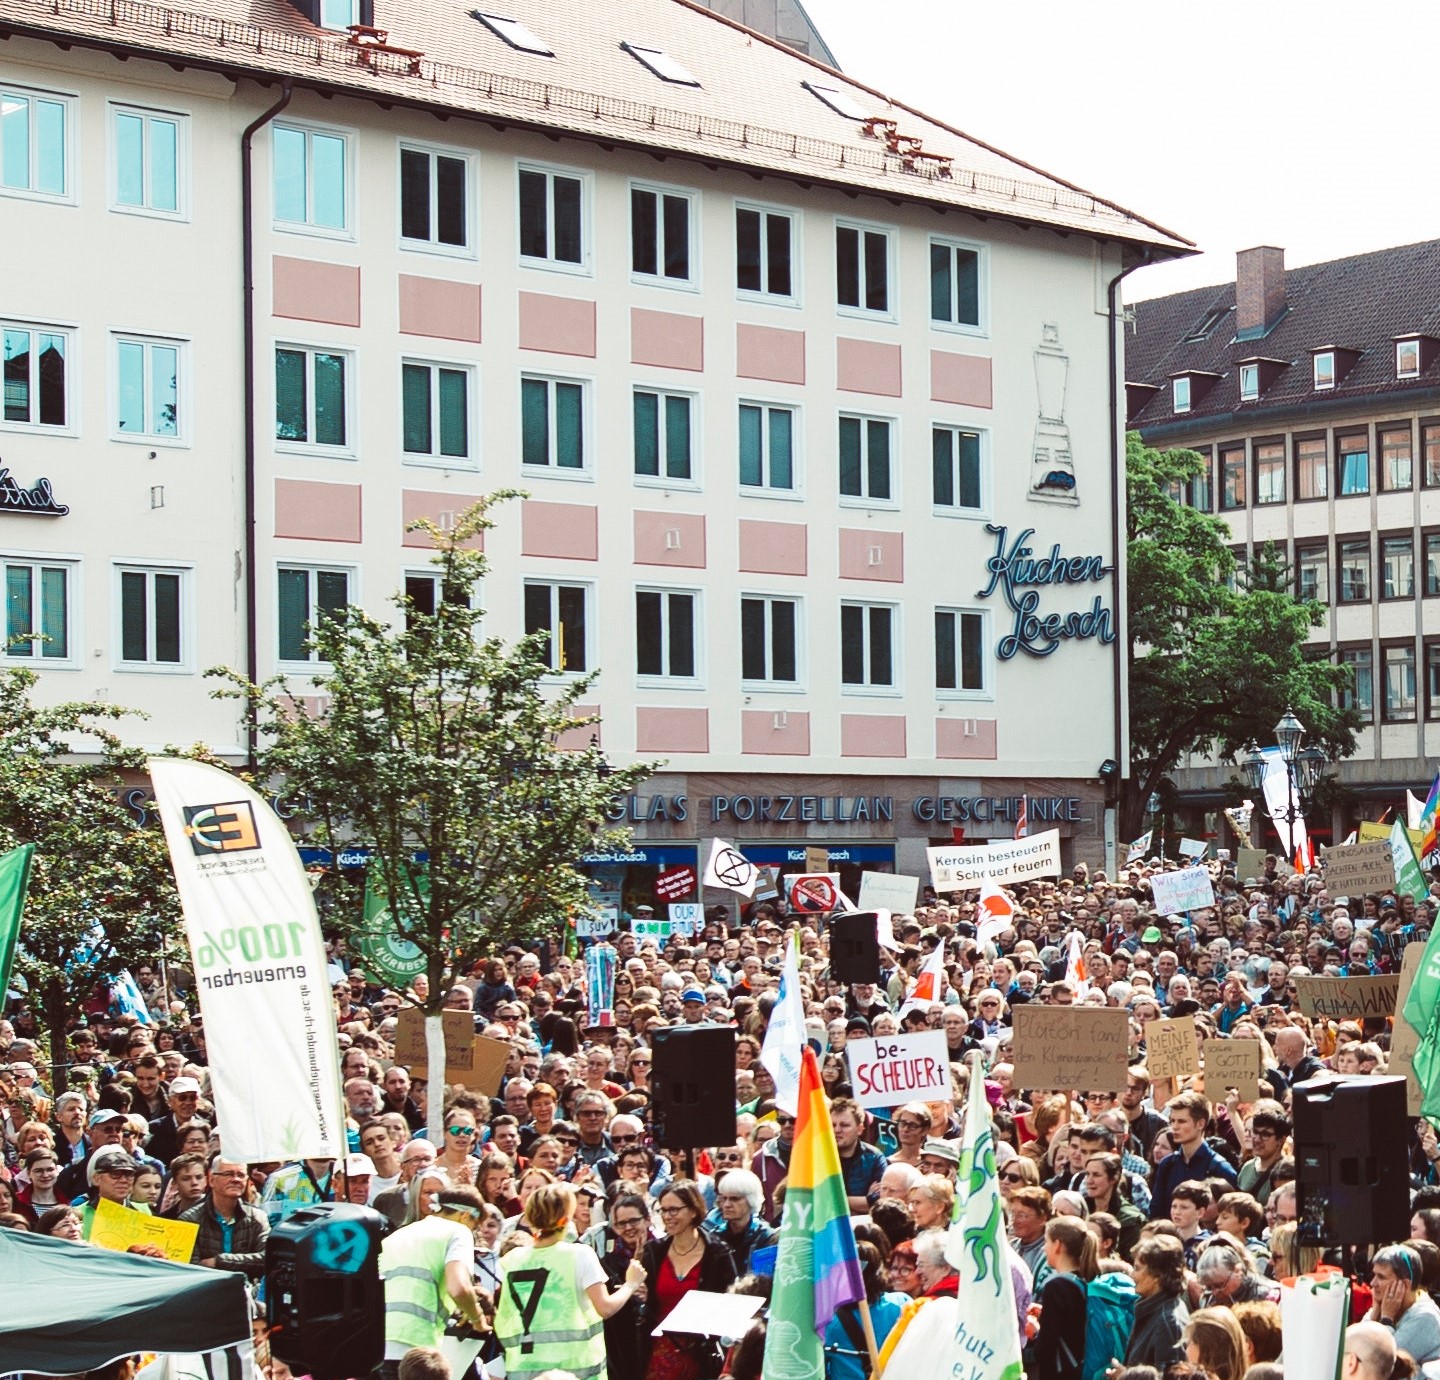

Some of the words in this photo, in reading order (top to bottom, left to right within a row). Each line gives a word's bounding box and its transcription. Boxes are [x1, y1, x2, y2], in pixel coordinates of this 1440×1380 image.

[974, 523, 1116, 598] Küchen-
[995, 591, 1117, 660] Loesch
[606, 794, 689, 823] GLAS
[712, 795, 895, 823] PORZELLAN
[912, 795, 1083, 823] GESCHENKE
[936, 854, 983, 867] Kerosin
[988, 843, 1050, 863] besteuern
[1012, 857, 1053, 874] feuern
[1154, 877, 1173, 886] Wir
[675, 905, 695, 919] OUR
[1299, 980, 1353, 1000] POLITIK
[1312, 997, 1363, 1015] KLIMA
[875, 1039, 907, 1060] be-
[1150, 1030, 1192, 1049] MEINE
[1152, 1057, 1193, 1077] DEINE
[1216, 1054, 1250, 1067] GOTT
[857, 1056, 944, 1095] SCHEUERt
